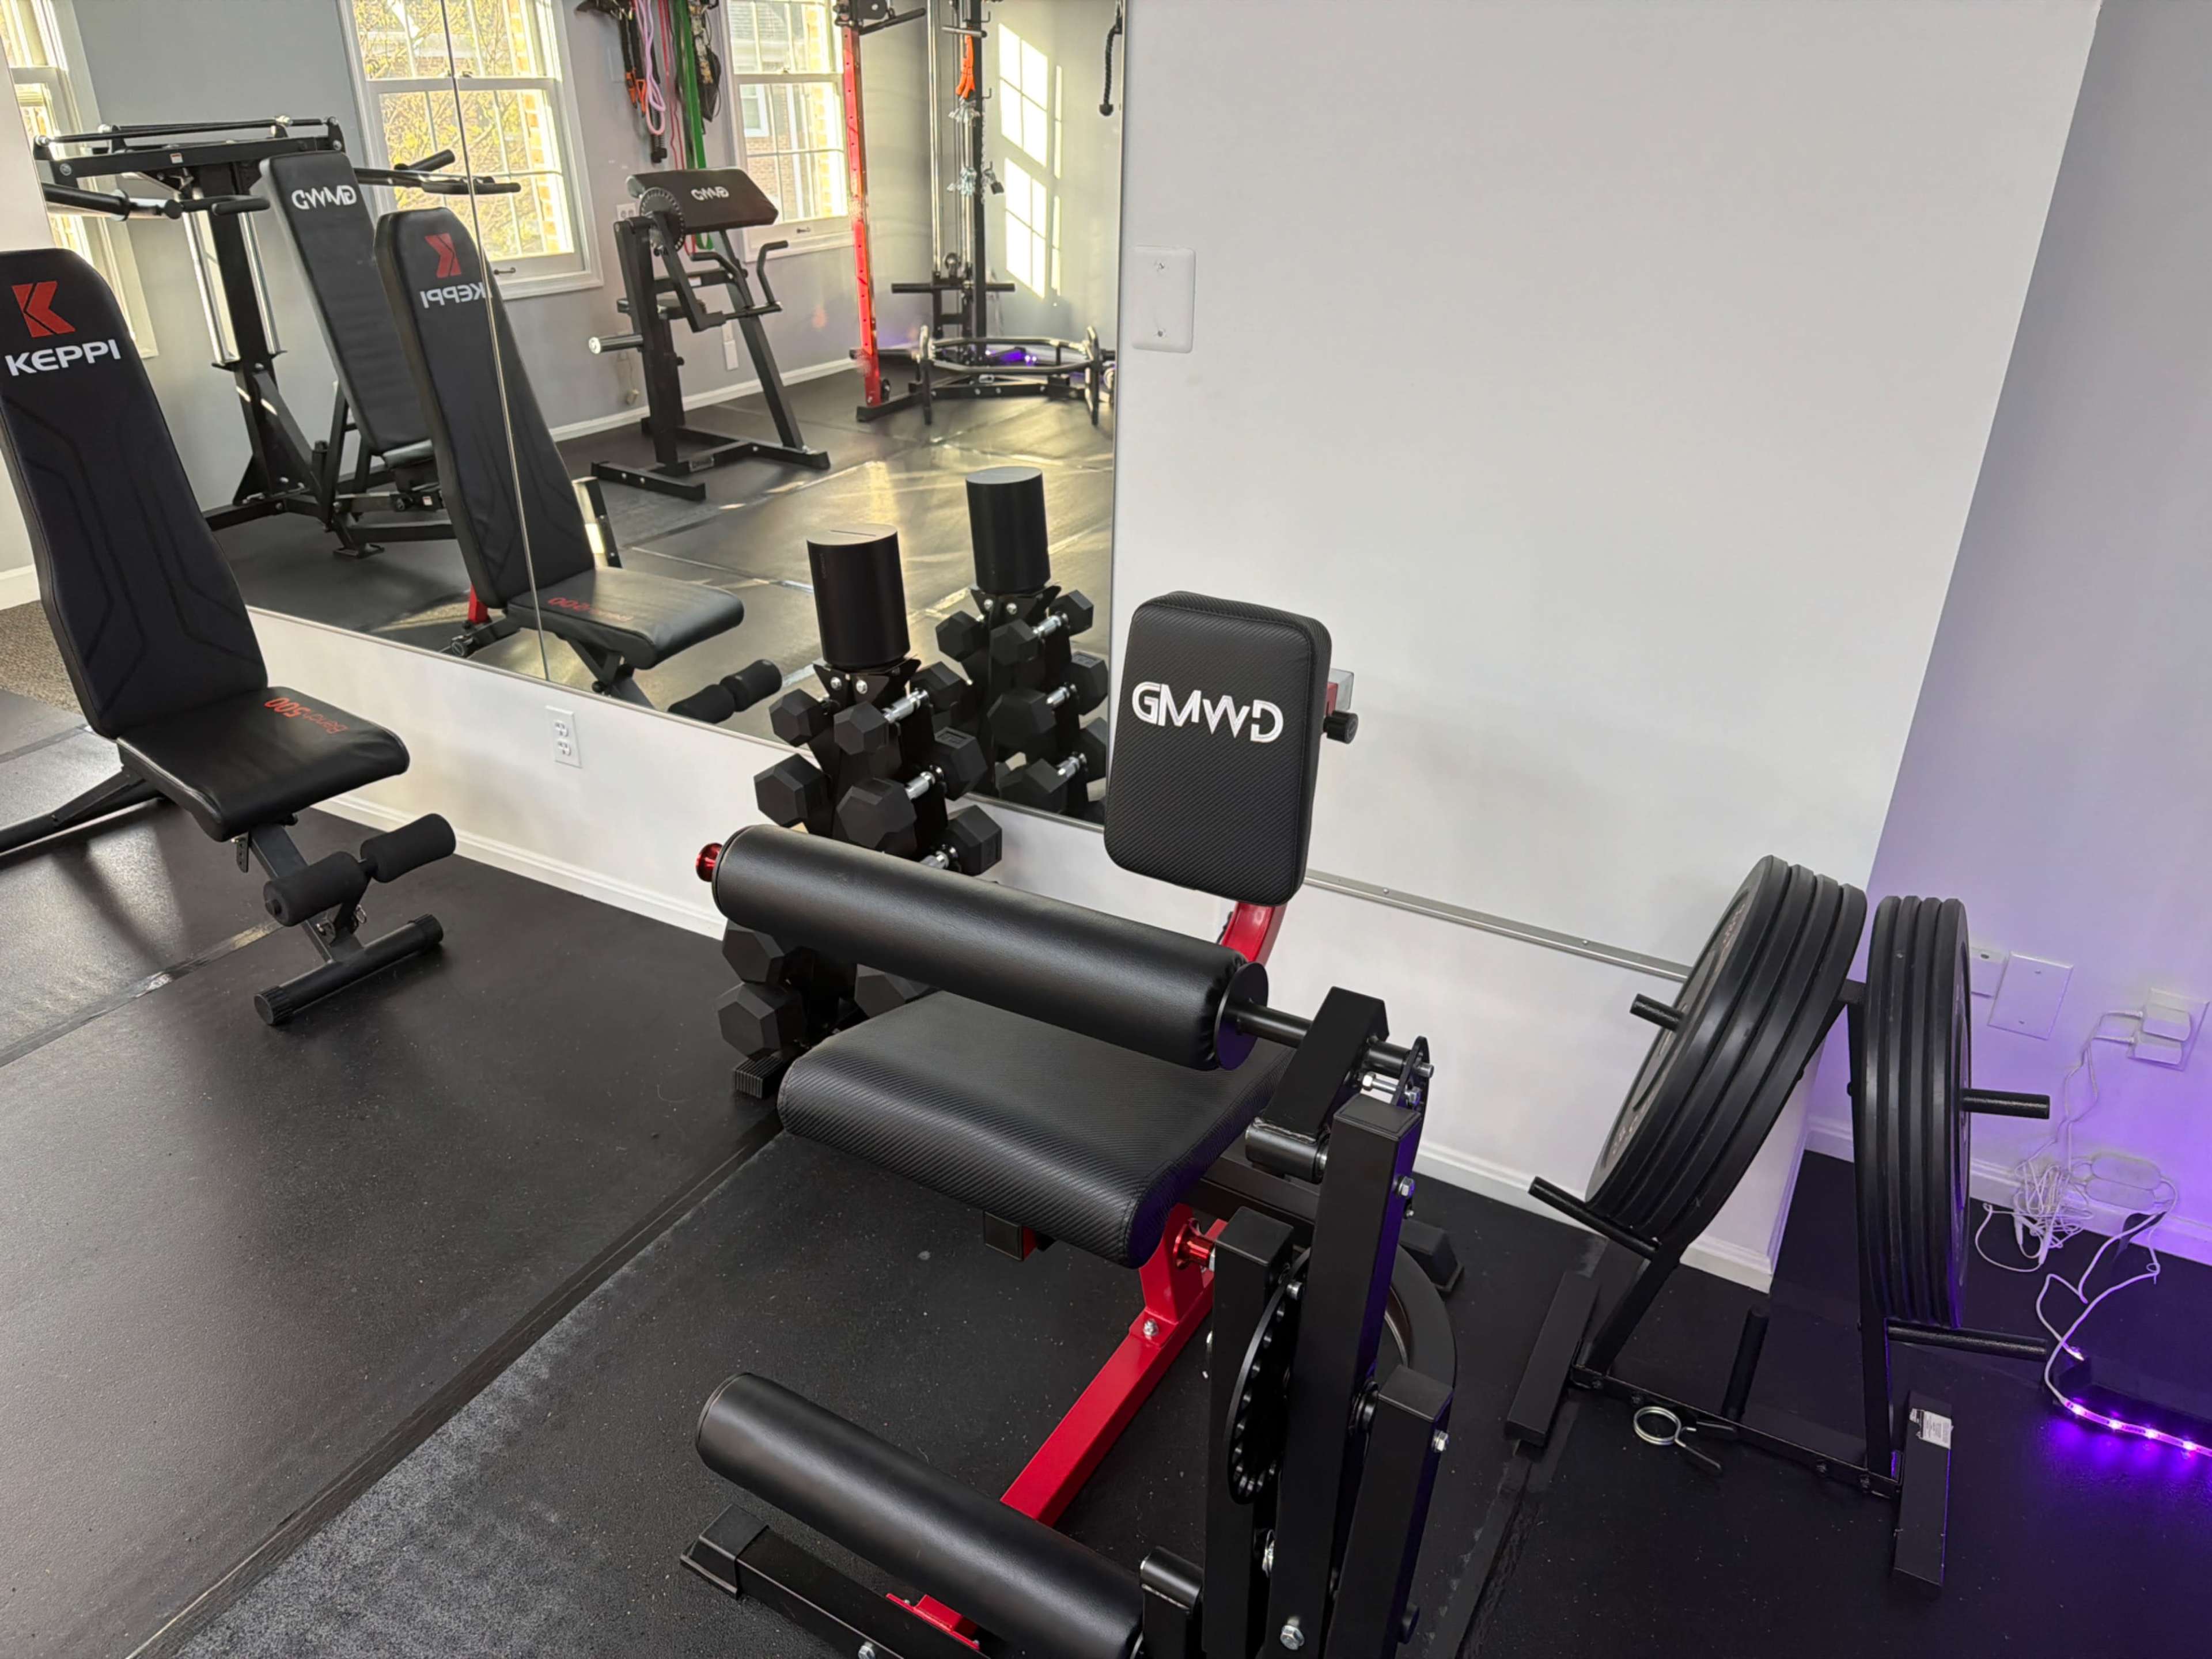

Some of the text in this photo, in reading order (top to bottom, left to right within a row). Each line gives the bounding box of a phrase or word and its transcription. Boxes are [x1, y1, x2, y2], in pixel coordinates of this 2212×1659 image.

[5, 339, 122, 376] KEPPI
[264, 697, 312, 718] 500
[1132, 681, 1284, 743] GMWD
